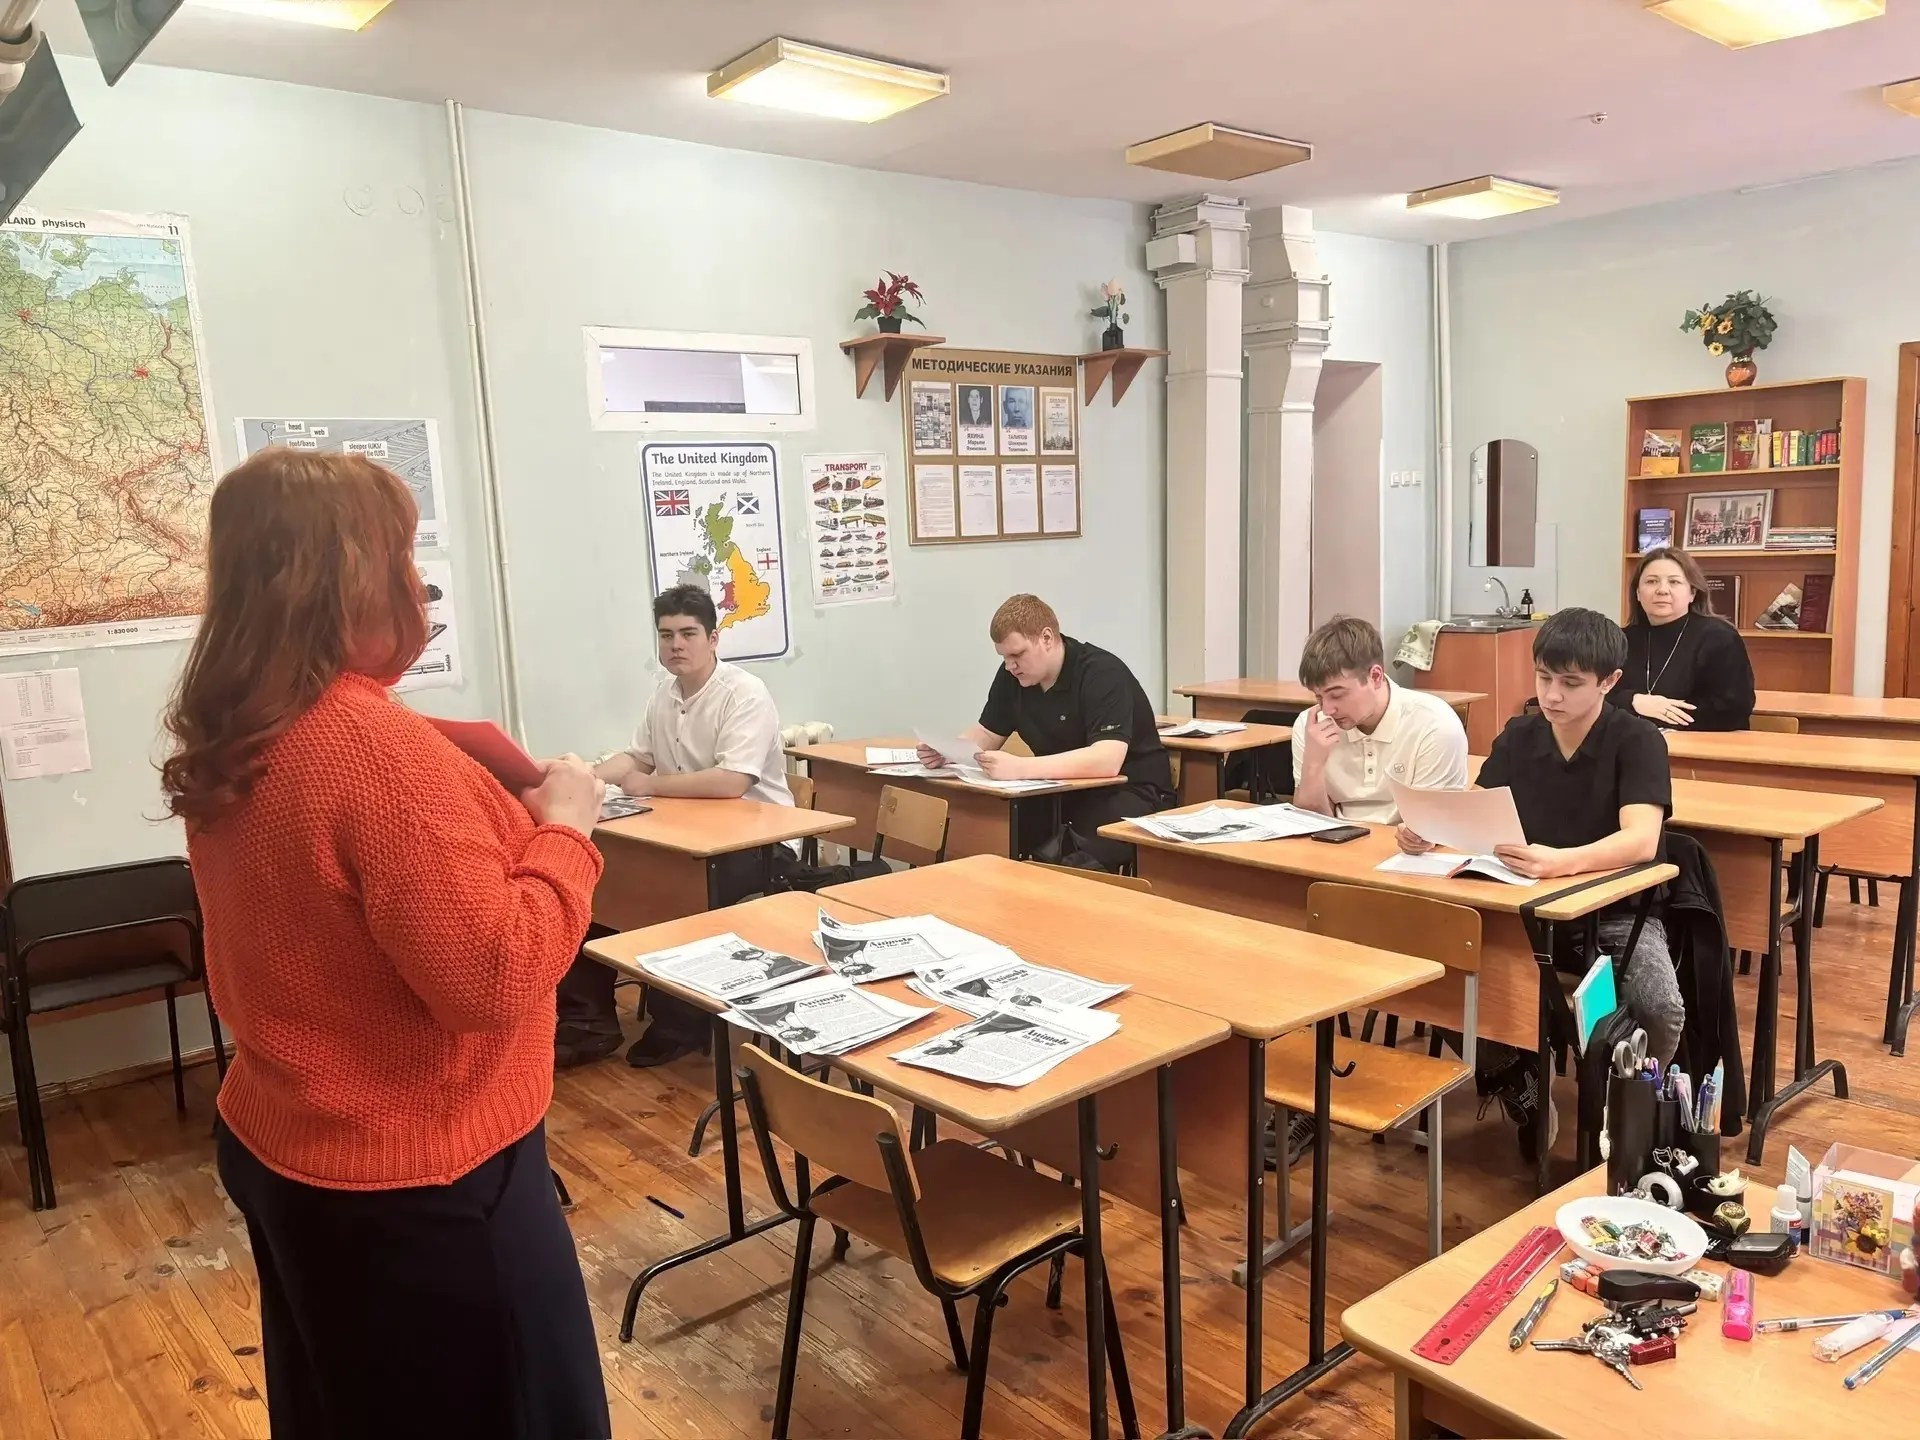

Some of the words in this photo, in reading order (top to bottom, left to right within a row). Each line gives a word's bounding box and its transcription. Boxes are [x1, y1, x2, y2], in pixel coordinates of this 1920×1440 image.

[42, 219, 86, 229] physisch
[912, 358, 1011, 374] МЕТОДИЧЕСКИЕ
[1014, 364, 1073, 377] УКАЗАНИЯ
[288, 423, 302, 431] head
[652, 452, 675, 464] The
[677, 452, 717, 464] United
[720, 452, 768, 466] Kingdom
[825, 463, 868, 472] TRANSPORT
[742, 470, 748, 478] of
[674, 478, 697, 486] England,
[798, 993, 847, 1008] Animals
[1027, 1029, 1070, 1045] Animals
